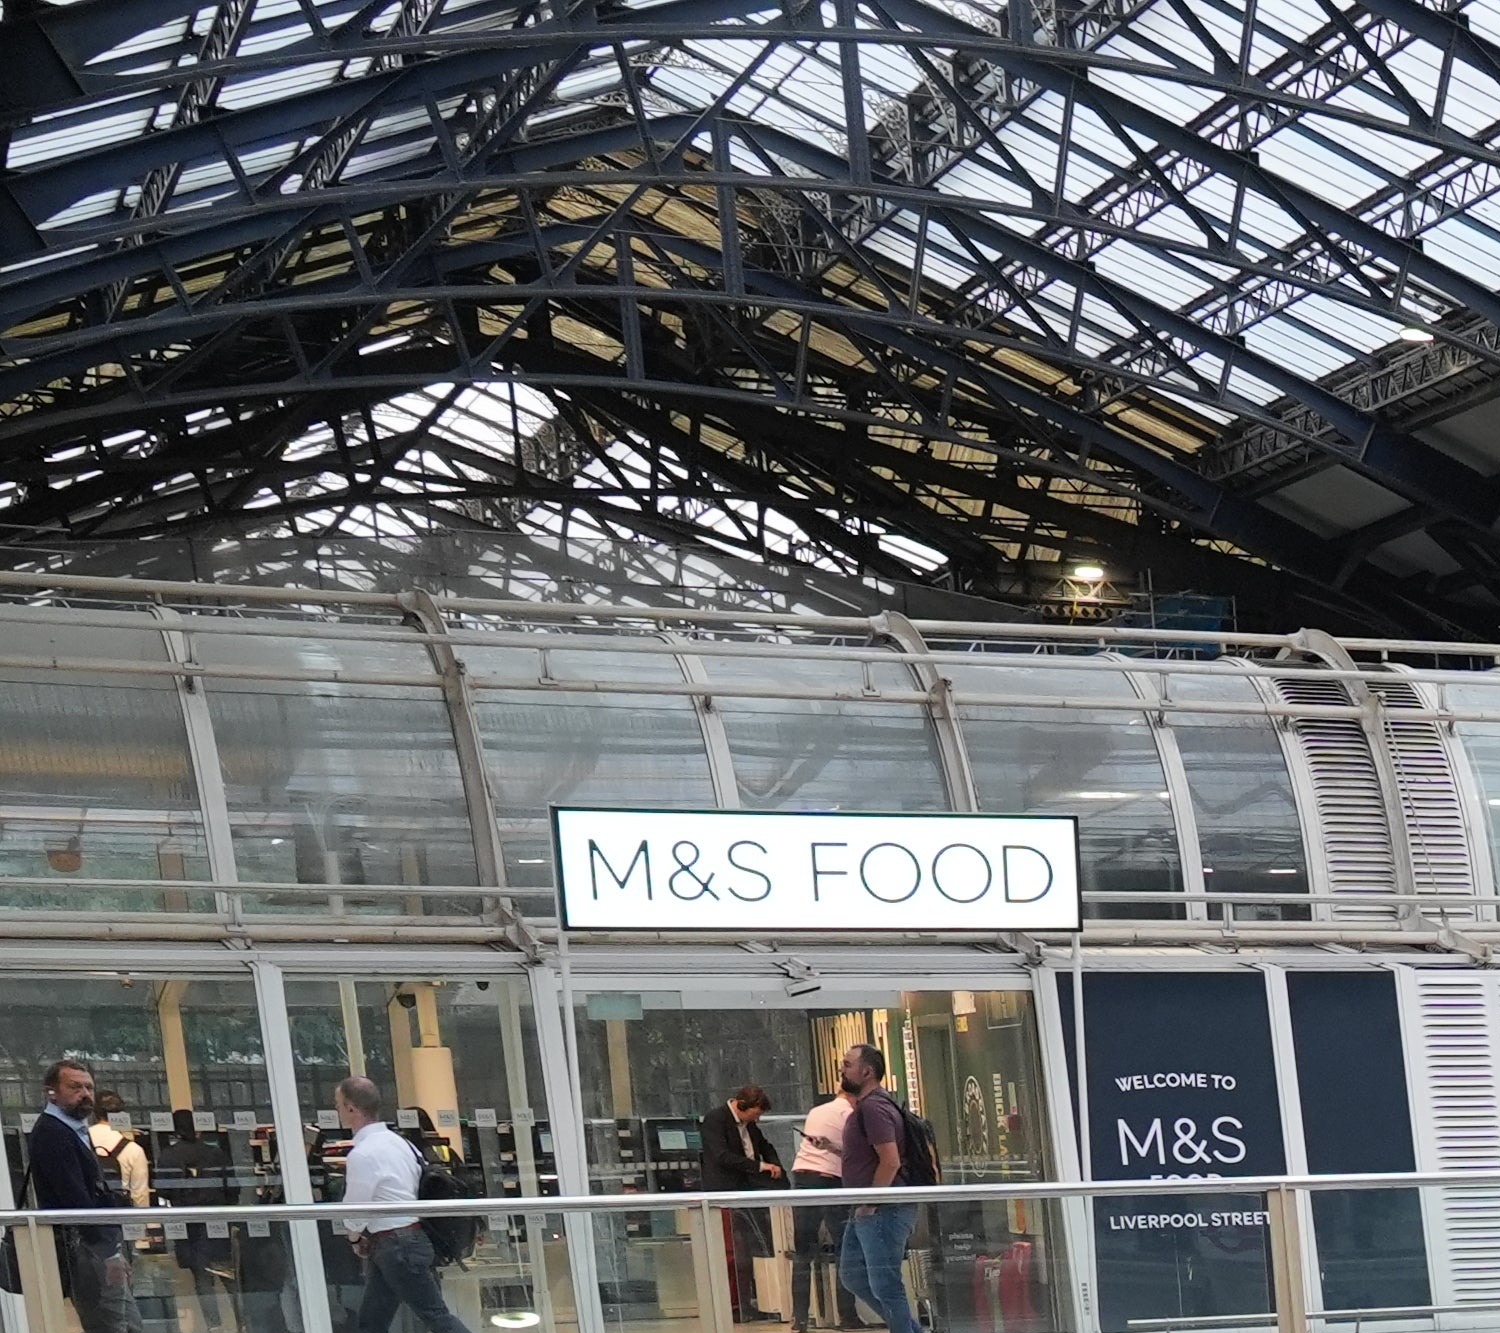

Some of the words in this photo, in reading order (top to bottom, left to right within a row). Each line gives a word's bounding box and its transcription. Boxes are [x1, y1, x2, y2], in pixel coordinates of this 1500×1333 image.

[588, 838, 773, 904] M&S
[812, 841, 1053, 904] FOOD
[1114, 1071, 1207, 1095] WELCOME
[1210, 1073, 1239, 1093] TO
[1117, 1117, 1248, 1166] M&S
[1110, 1212, 1208, 1230] LIVERPOOL
[1211, 1211, 1270, 1227] STREET
